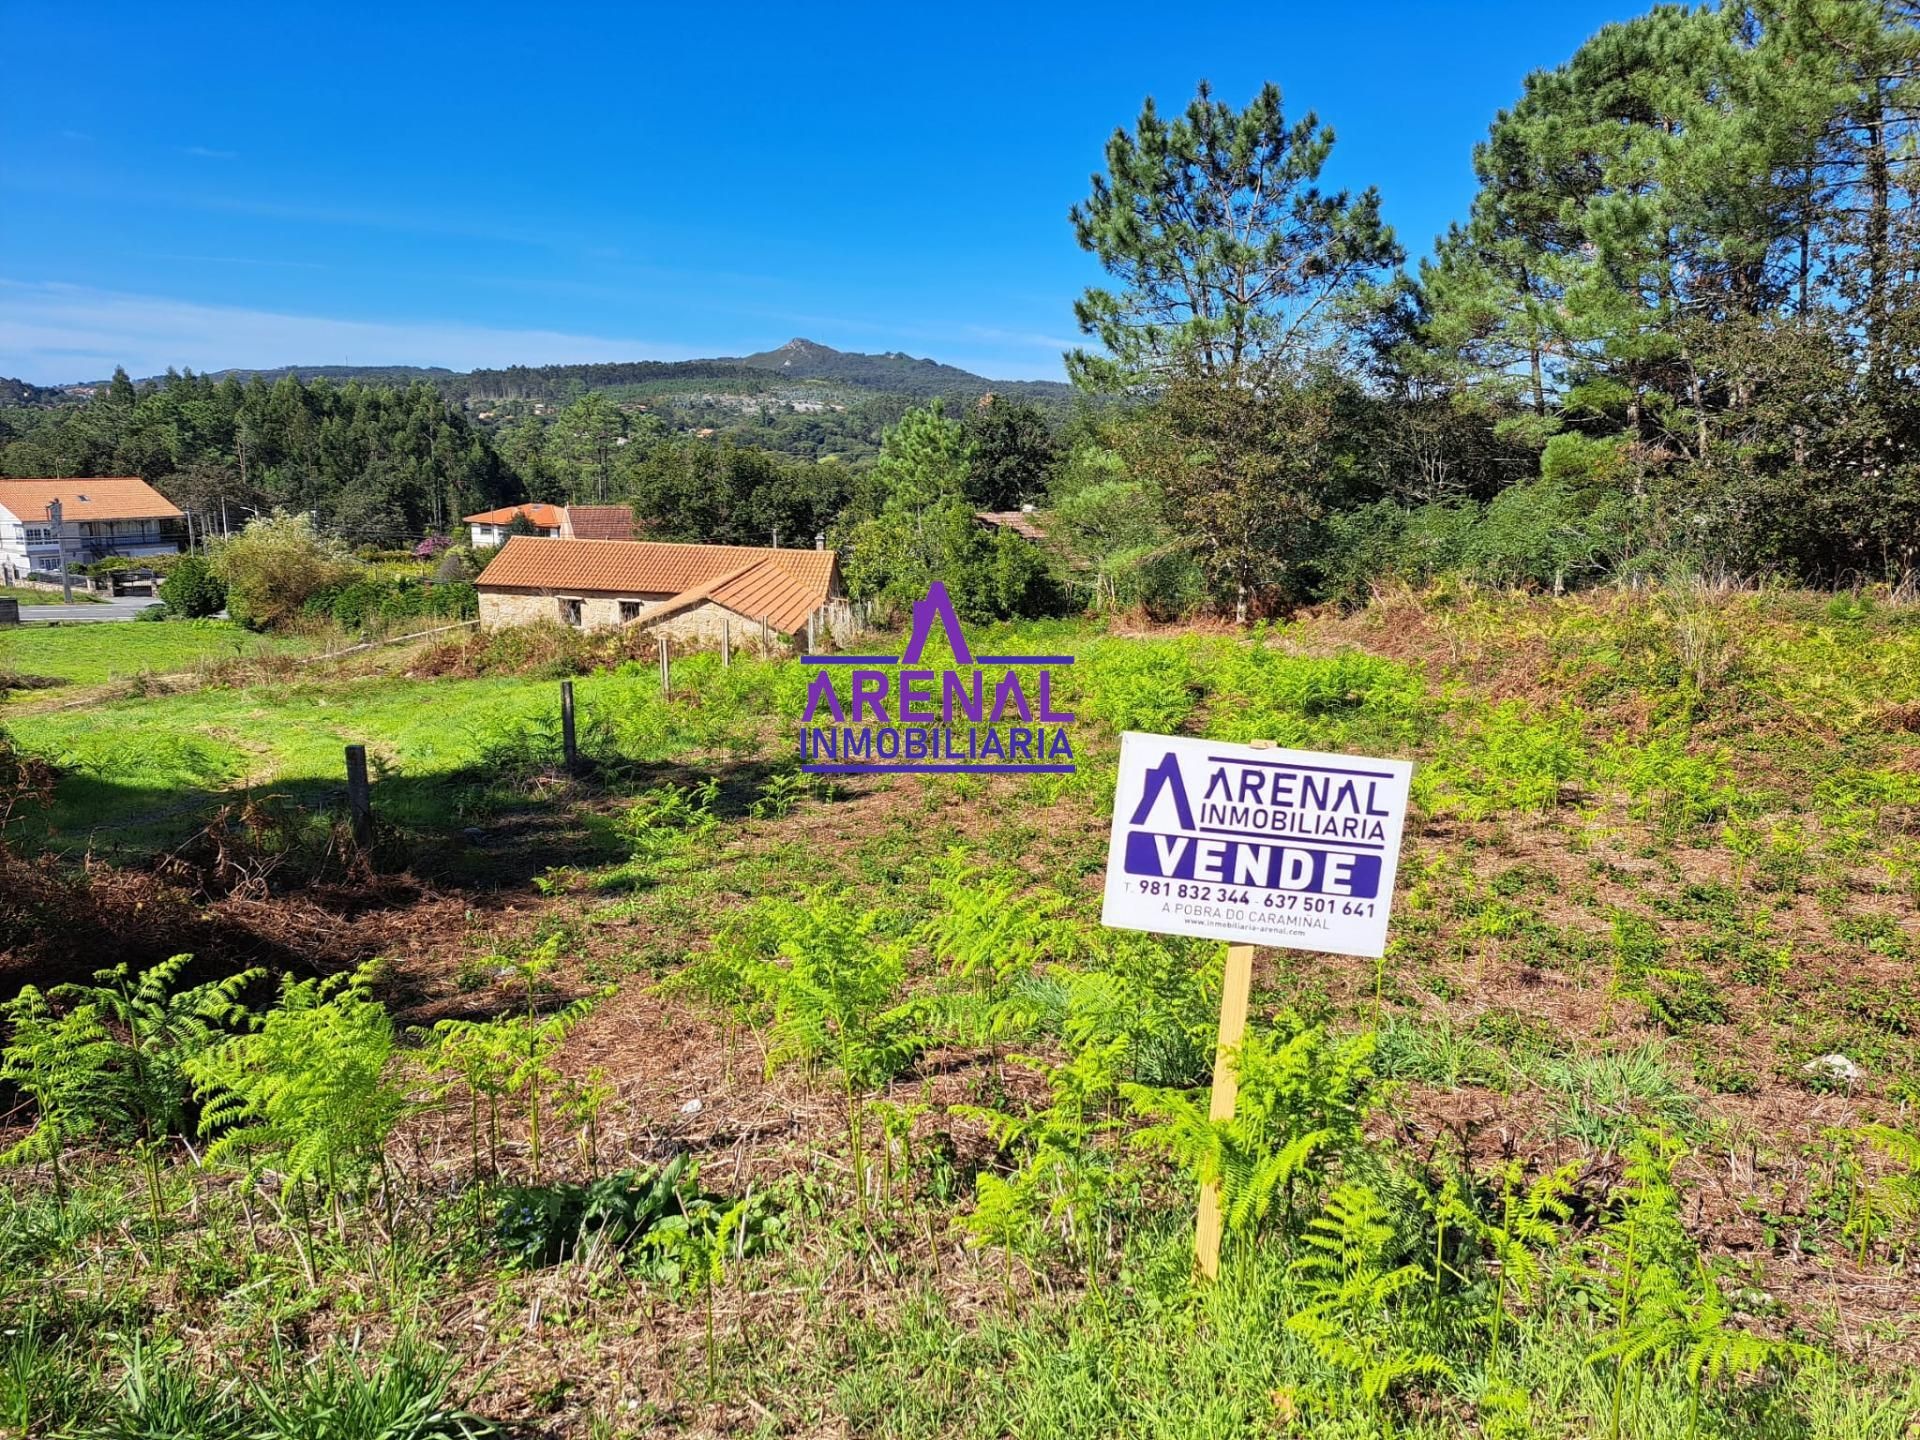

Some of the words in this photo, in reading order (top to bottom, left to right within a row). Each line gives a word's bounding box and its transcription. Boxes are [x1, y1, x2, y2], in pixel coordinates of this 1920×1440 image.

[1204, 767, 1389, 817] ARENAL
[1200, 802, 1385, 841] INMOBILIARIA
[1153, 834, 1356, 896] VENDE
[1140, 880, 1170, 897] 981
[1178, 884, 1211, 901] 832
[1216, 888, 1250, 905] 344
[1264, 893, 1298, 910] 637
[1303, 896, 1335, 914] 501
[1342, 901, 1375, 918] 641
[1161, 902, 1170, 913] A
[1175, 903, 1221, 918] POBRA
[1226, 908, 1244, 921] DO
[1248, 911, 1331, 930] CARAMIÑAL
[1184, 919, 1306, 937] www.inmobiliaria-arenal.com
